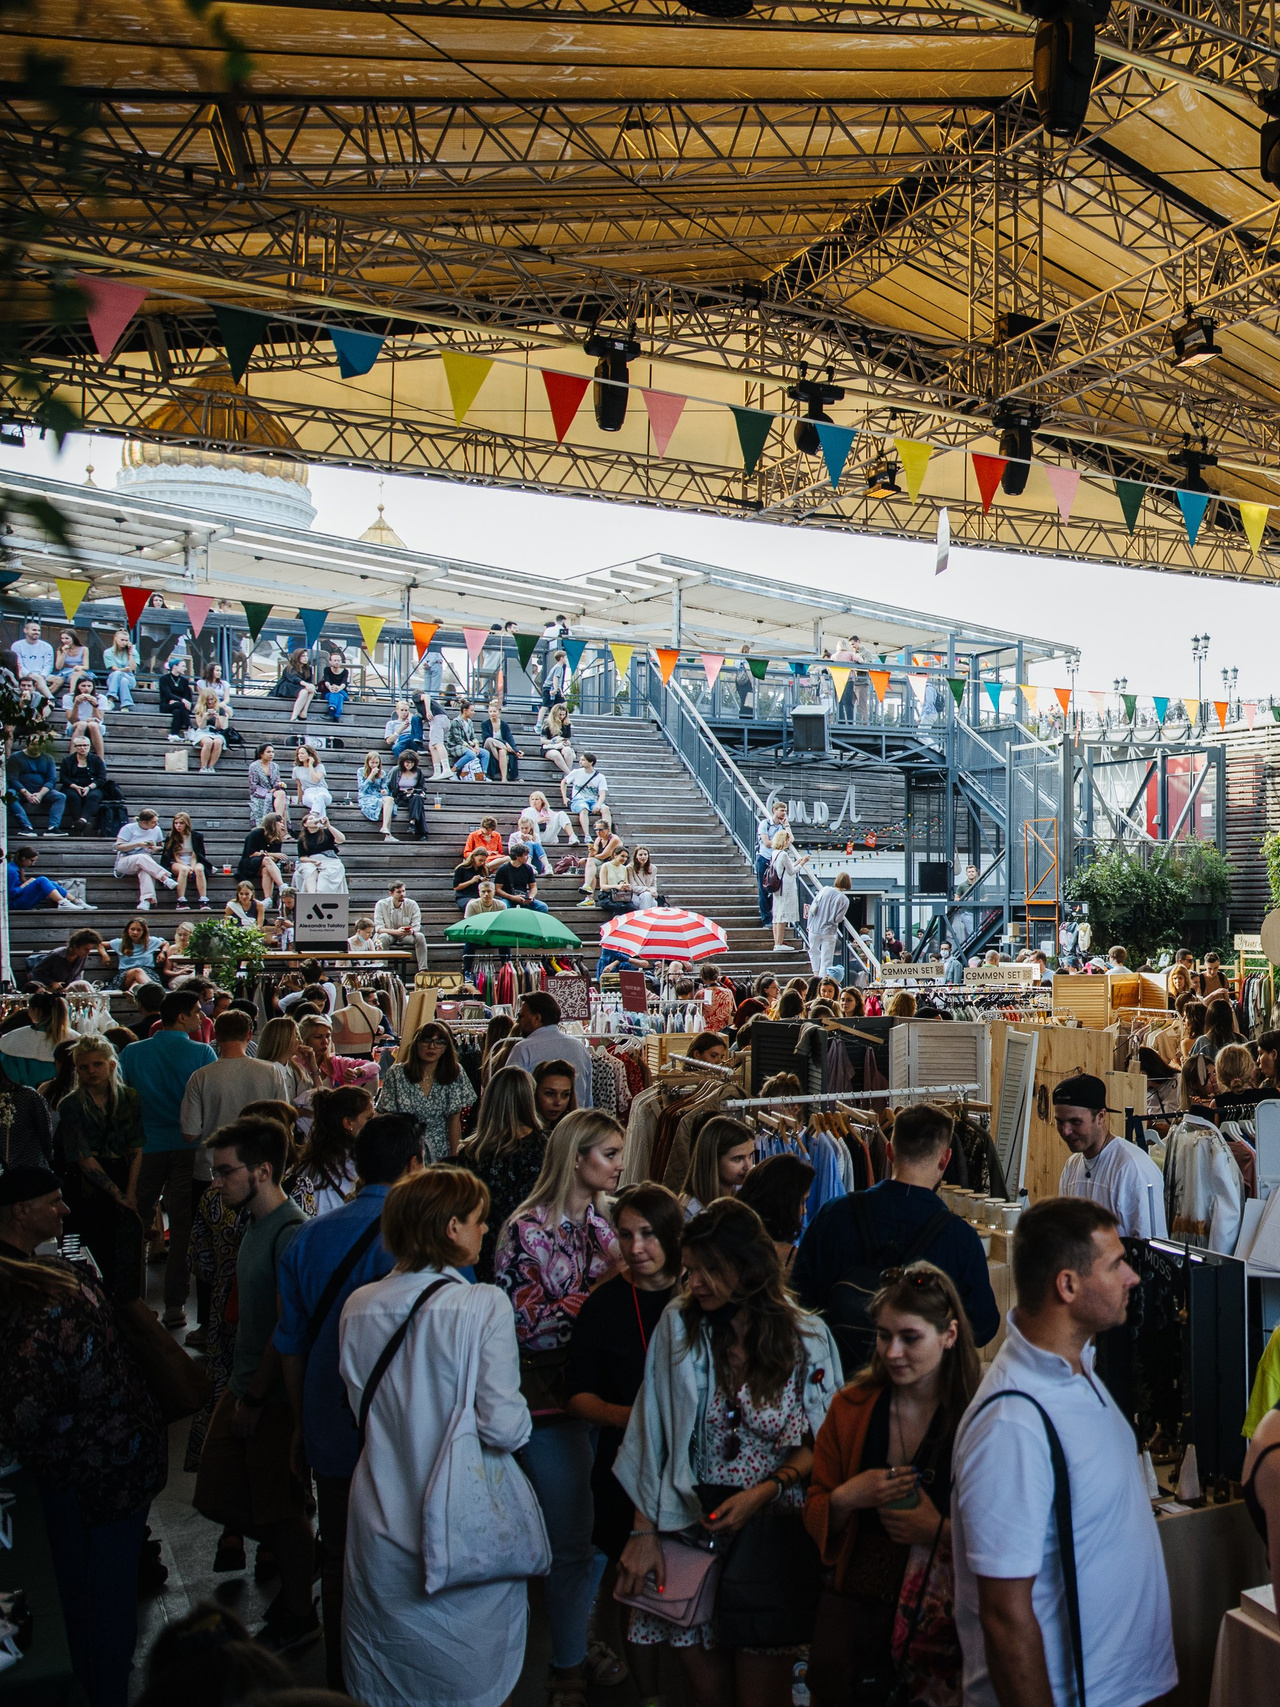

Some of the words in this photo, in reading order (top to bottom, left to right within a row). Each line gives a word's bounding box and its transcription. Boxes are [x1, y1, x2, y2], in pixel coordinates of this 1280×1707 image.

[881, 966, 919, 976] COMMON
[920, 966, 934, 975] SET
[965, 971, 1005, 980] COMMON
[1007, 970, 1021, 979] SET
[1144, 1247, 1172, 1281] MOSS
